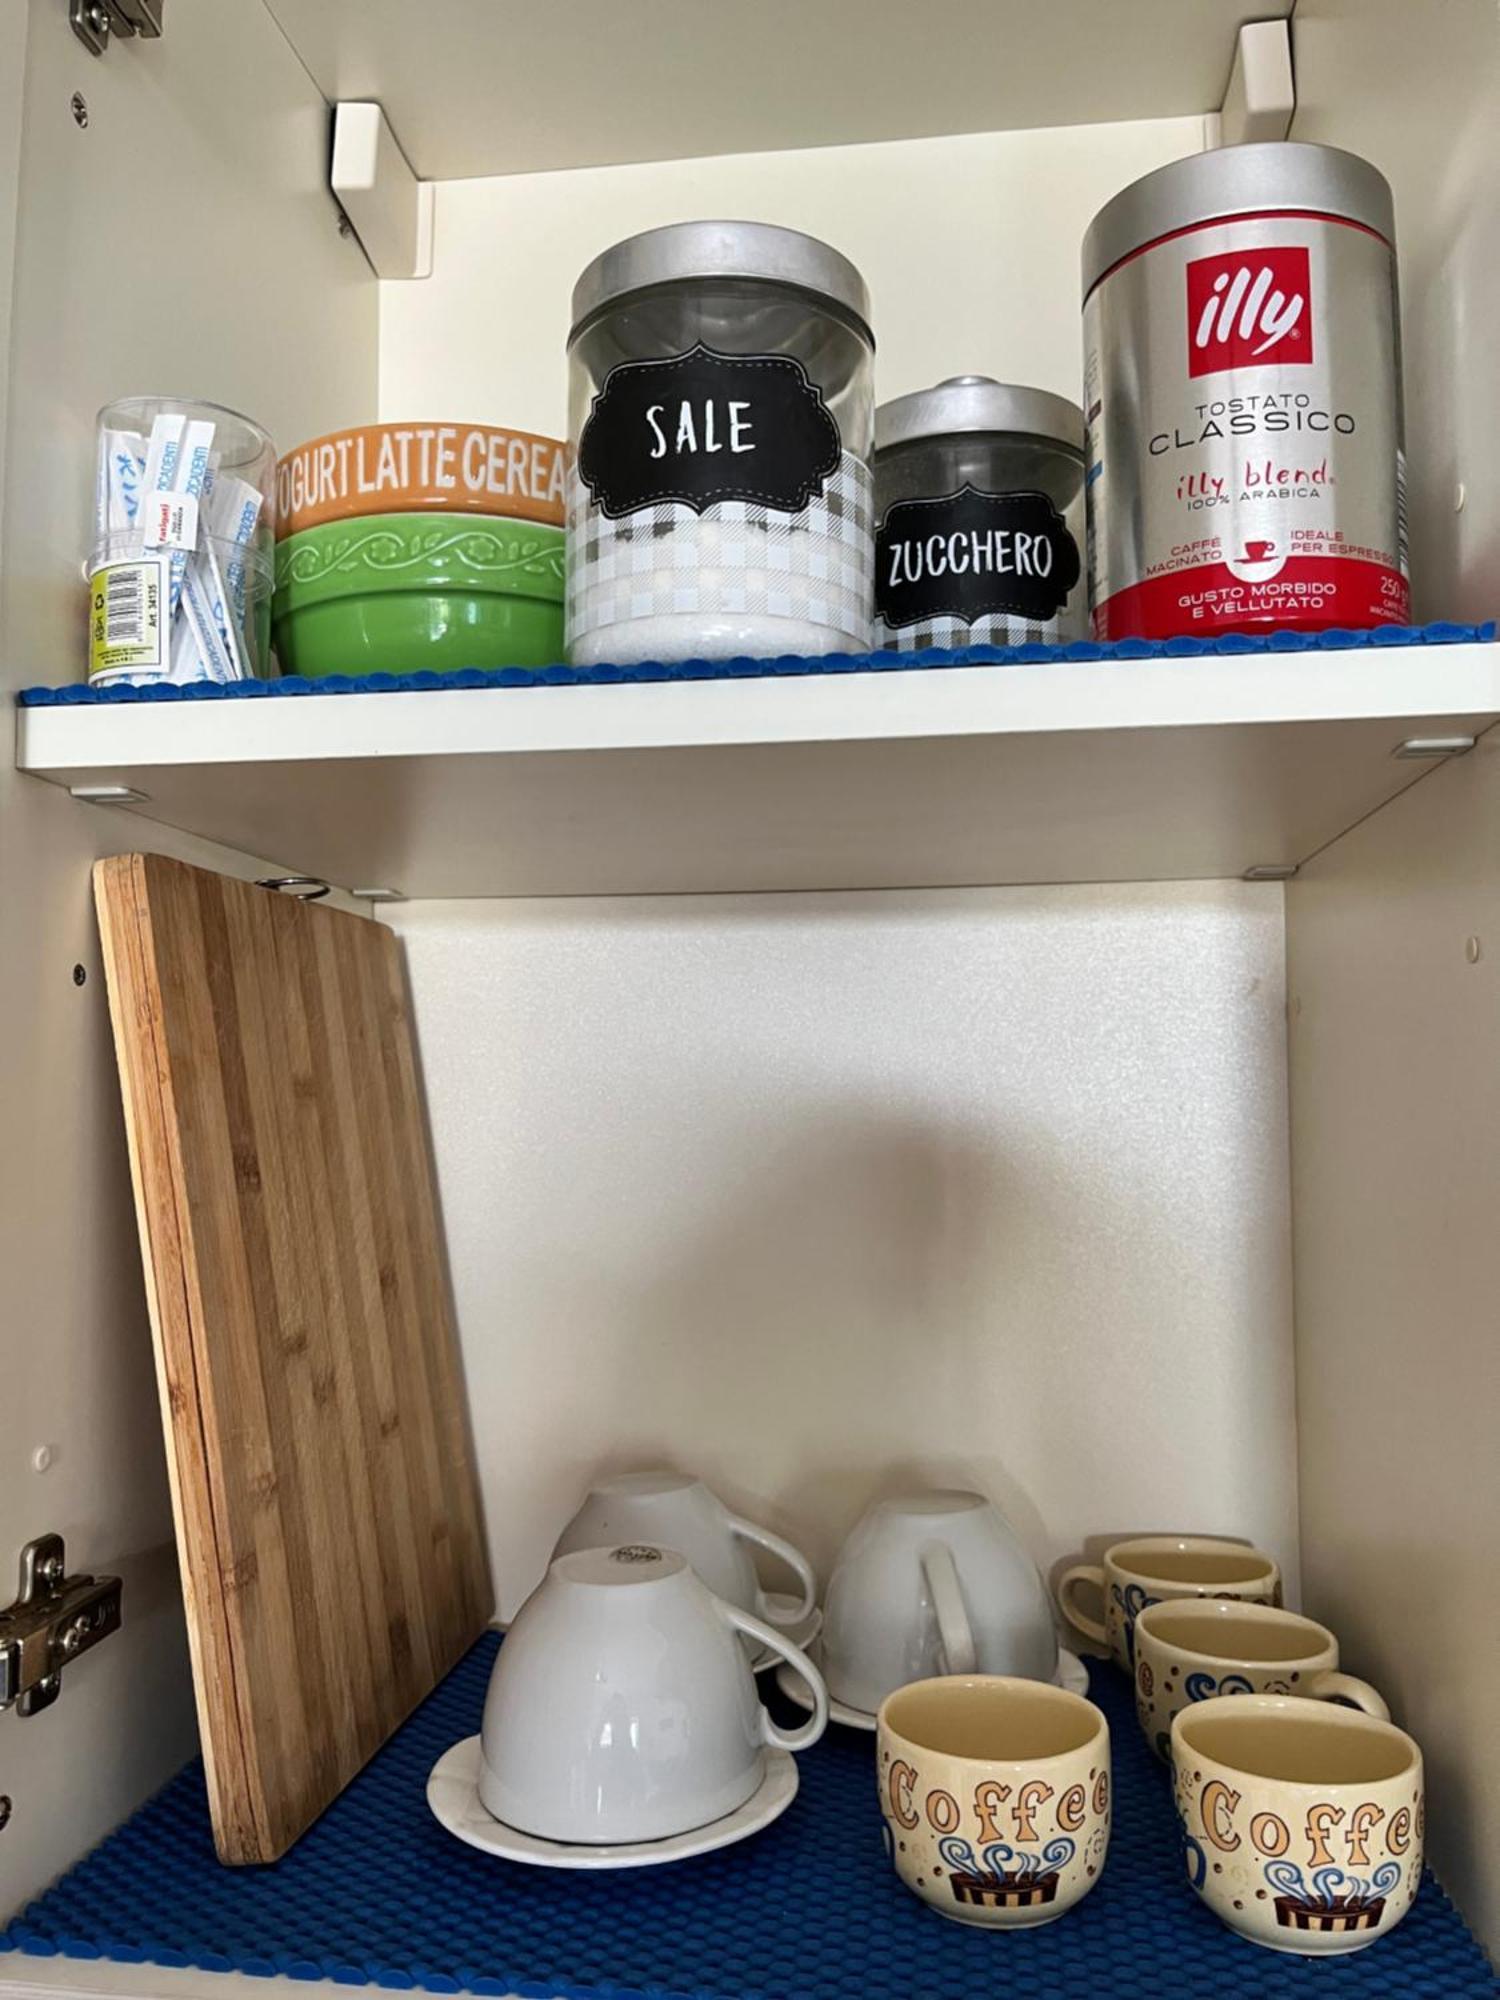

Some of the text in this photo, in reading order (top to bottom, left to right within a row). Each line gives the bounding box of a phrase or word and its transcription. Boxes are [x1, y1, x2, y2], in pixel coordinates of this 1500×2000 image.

[1195, 266, 1304, 357] illy
[1194, 393, 1310, 420] TOSTATO
[646, 399, 756, 458] SALE
[1148, 411, 1356, 456] CLASSICO
[277, 428, 566, 518] OGURT LATTE CEREA
[1175, 457, 1328, 502] illy blend
[1187, 487, 1321, 512] 100% ARABICA
[1290, 530, 1344, 542] IDEALE
[1291, 541, 1395, 566] PER ESPRESSO
[888, 529, 1053, 588] ZUCCHERO
[1145, 549, 1223, 577] MACINATO
[1178, 582, 1338, 609] GUSTO MORBIDO
[1192, 596, 1325, 619] E VELLUTATO
[889, 1759, 1109, 1845] Coffee
